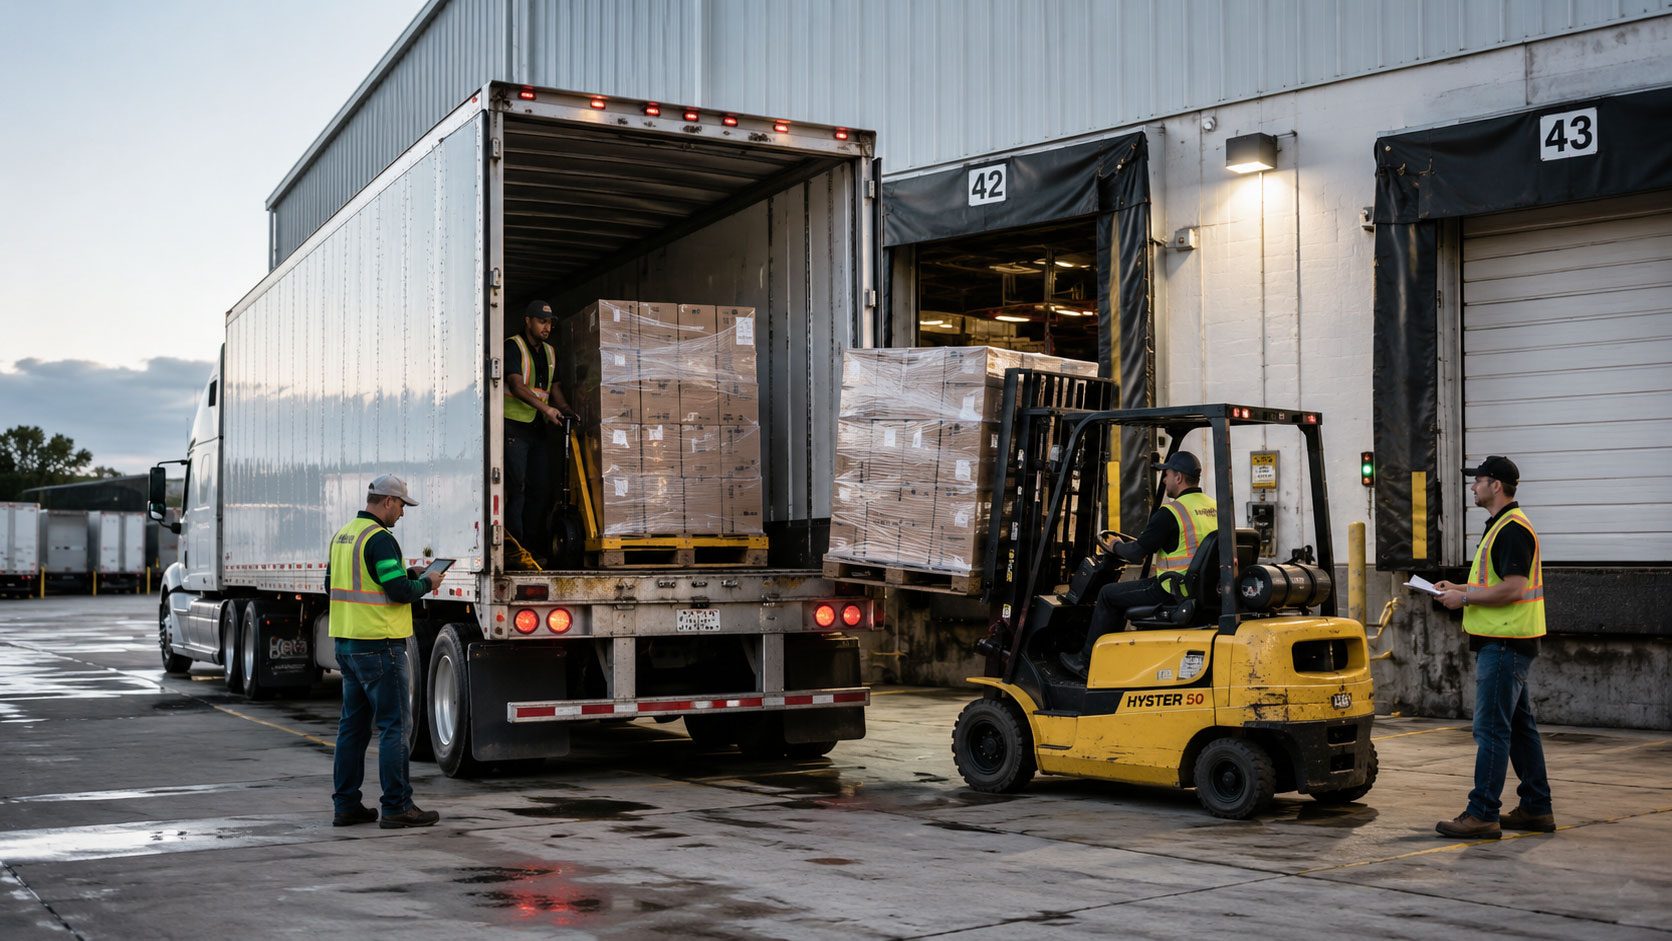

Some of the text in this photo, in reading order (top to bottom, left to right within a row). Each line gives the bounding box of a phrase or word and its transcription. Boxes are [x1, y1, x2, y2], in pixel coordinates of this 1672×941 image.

[1545, 115, 1593, 152] 43
[972, 170, 1003, 199] 42
[1127, 693, 1204, 708] HYSTER 50
